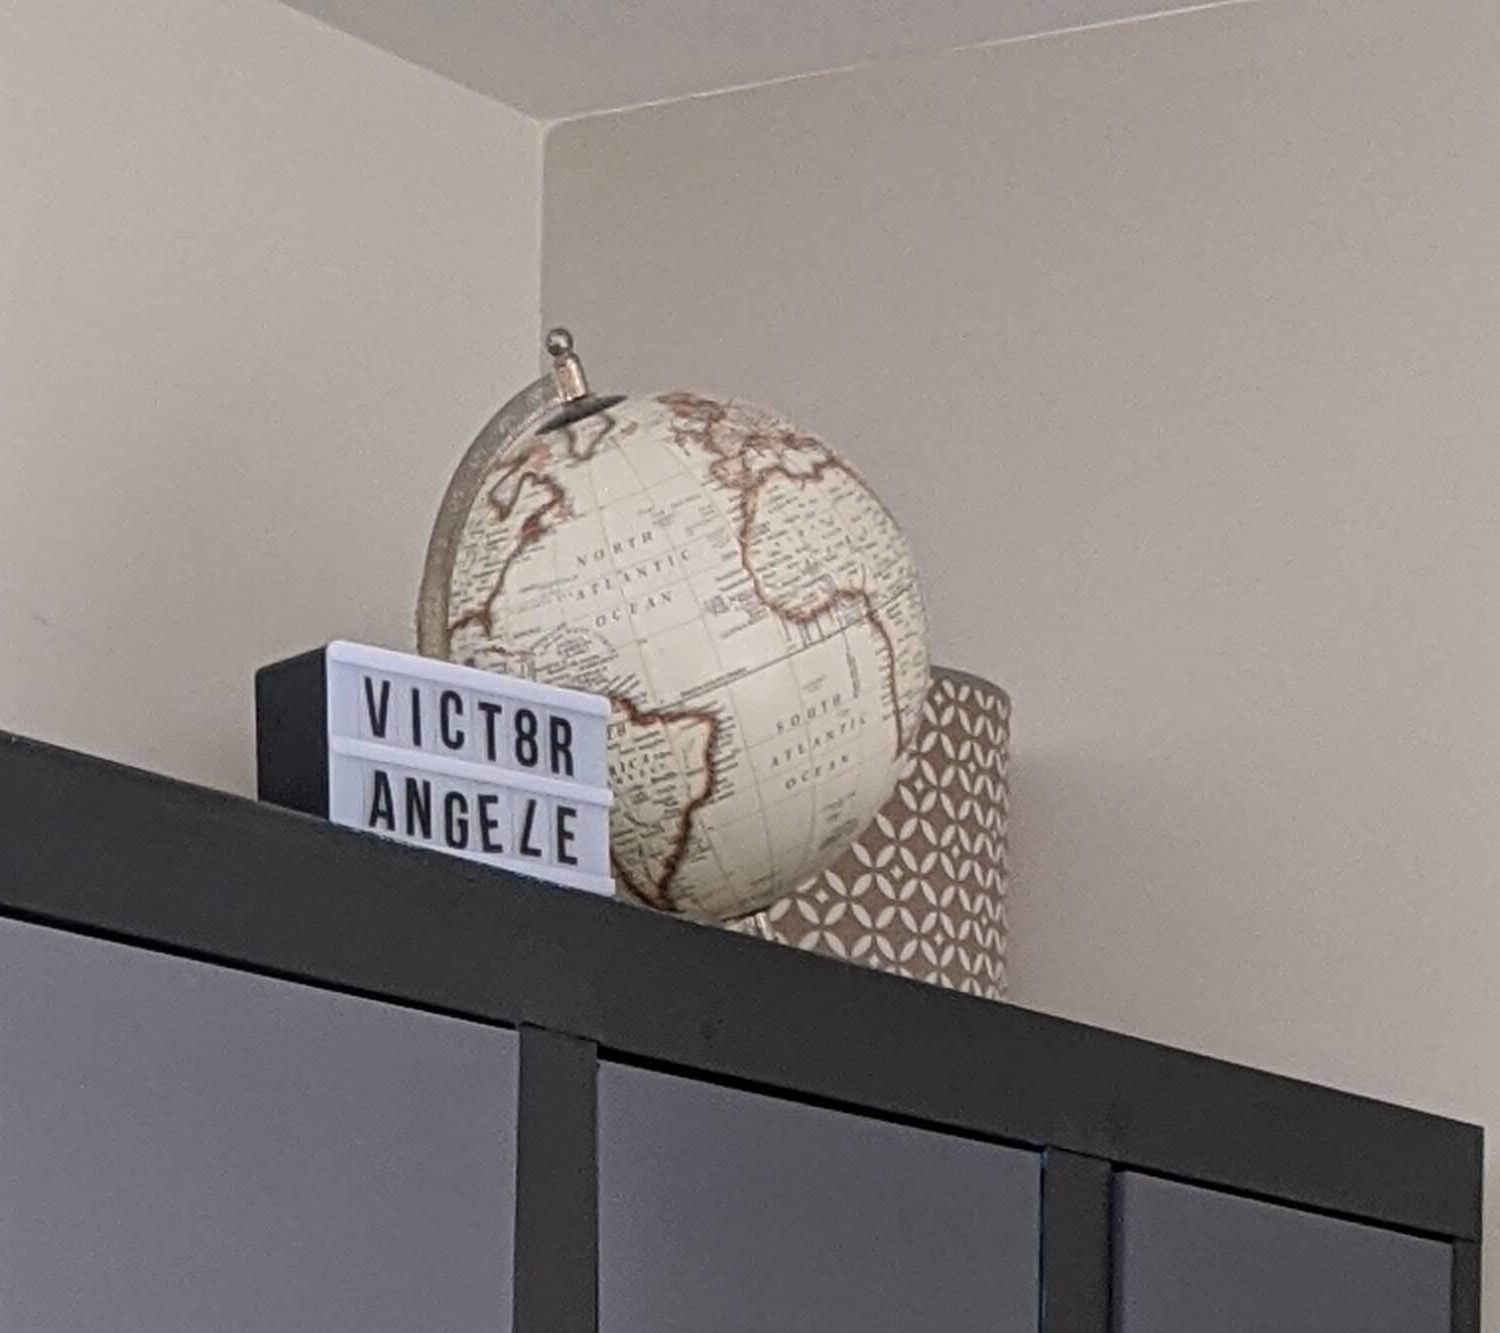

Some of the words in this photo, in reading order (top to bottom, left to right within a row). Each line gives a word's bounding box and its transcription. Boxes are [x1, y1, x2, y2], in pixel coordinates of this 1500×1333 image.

[577, 530, 652, 566] NORTH
[595, 590, 672, 628] OCEAN
[364, 677, 574, 777] VICT8R
